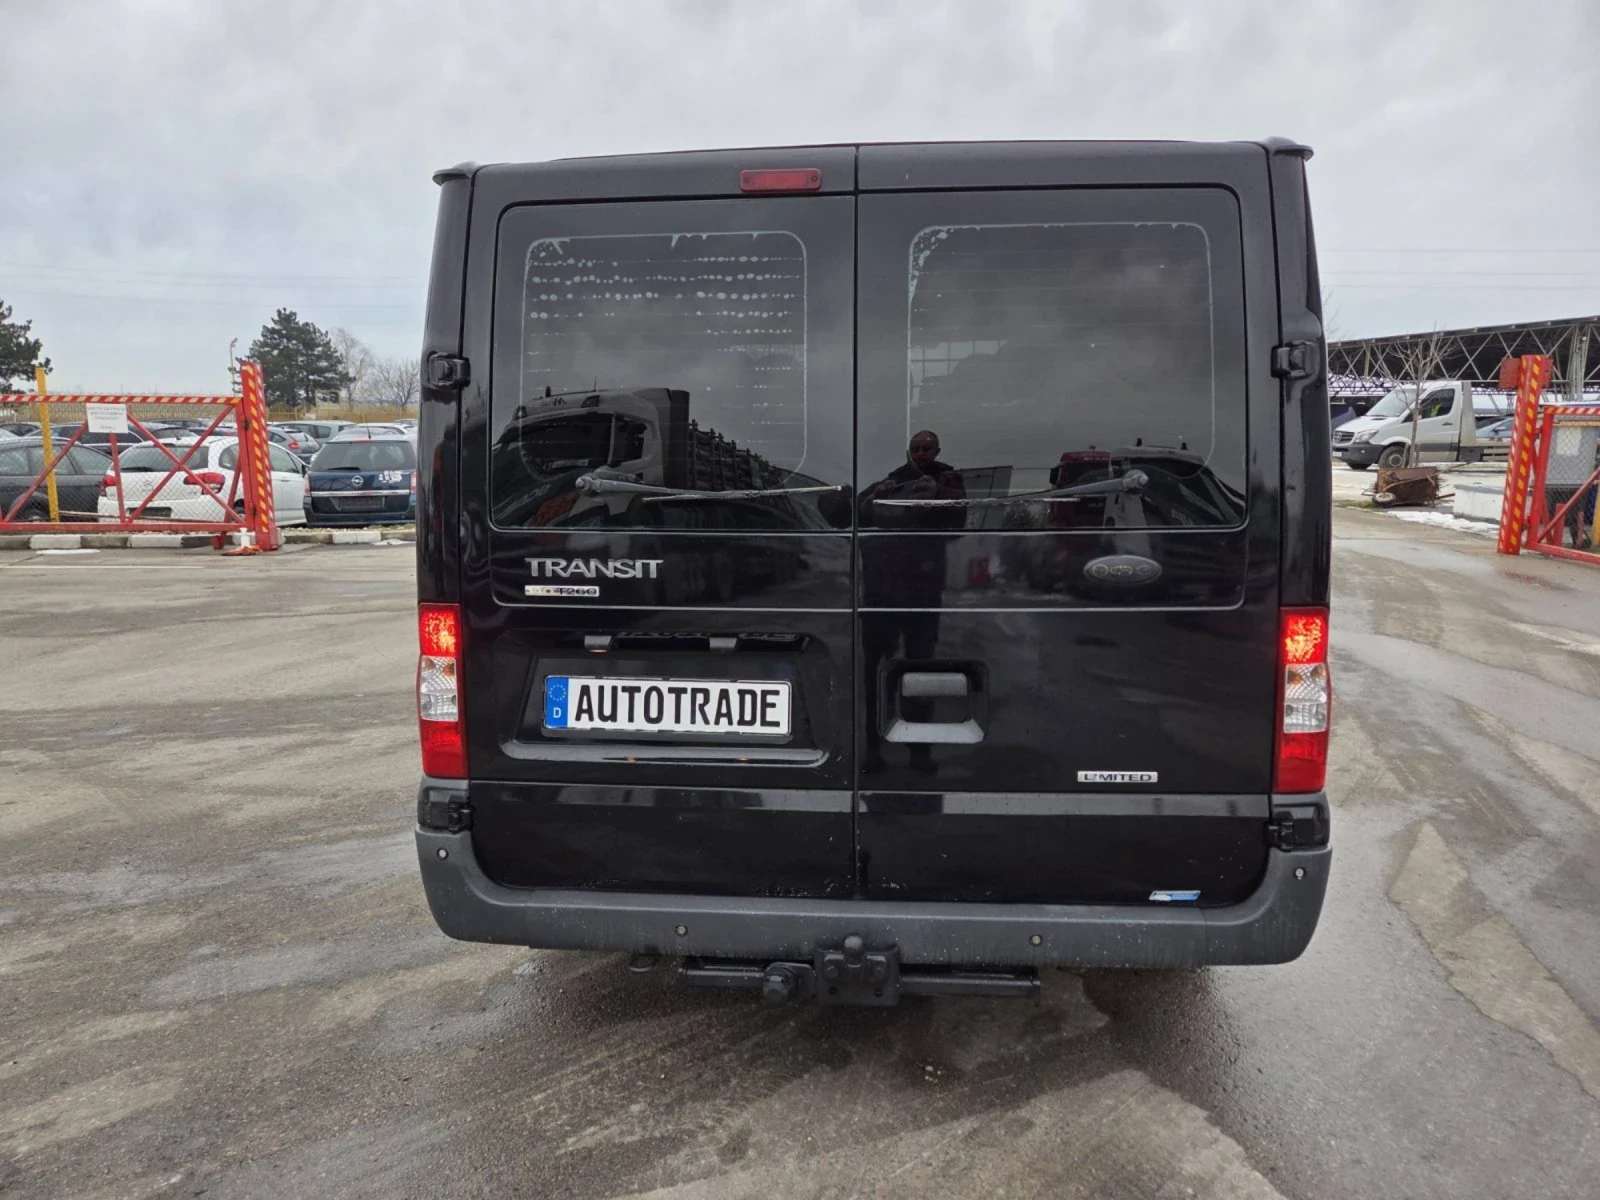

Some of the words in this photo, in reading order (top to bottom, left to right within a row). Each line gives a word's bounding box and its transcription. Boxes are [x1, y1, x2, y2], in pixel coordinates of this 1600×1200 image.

[524, 558, 664, 578] TRANSIT
[553, 707, 562, 718] D
[575, 685, 780, 727] AUTOTRADE
